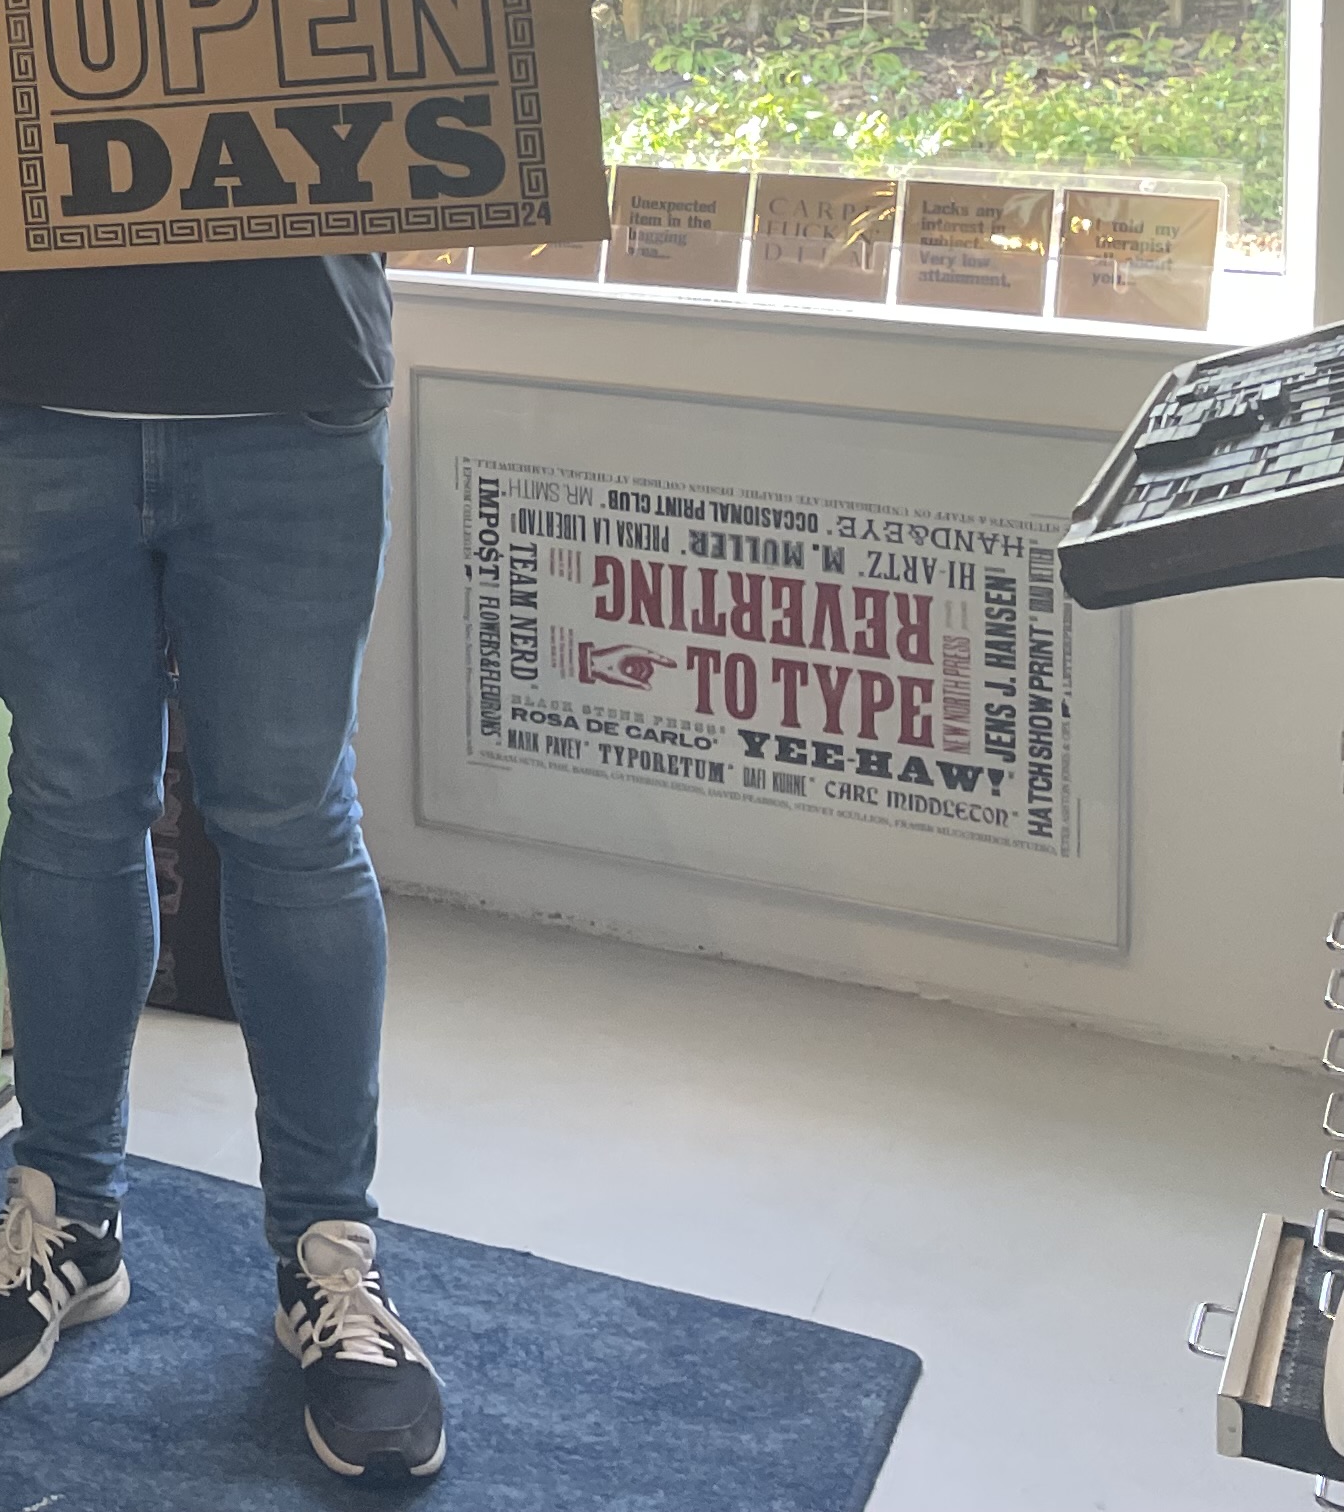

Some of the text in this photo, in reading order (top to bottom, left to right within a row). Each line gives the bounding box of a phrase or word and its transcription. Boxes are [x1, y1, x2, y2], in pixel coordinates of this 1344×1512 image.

[54, 94, 508, 218] DAYS
[521, 200, 551, 227] 24
[629, 212, 712, 229] item in the
[630, 195, 717, 214] Unexpected
[922, 200, 968, 217] Lacks
[1154, 224, 1180, 238] my
[918, 251, 958, 268] Very
[508, 479, 1024, 558] HAND&EYE OCCASIONAL PRINT CLUB MR. SMITH
[518, 507, 586, 541] LIBERTAD
[593, 517, 611, 543] LA
[616, 519, 670, 552] PRENSA
[812, 543, 845, 575] M.
[866, 551, 976, 591] HI-ARTZ
[510, 542, 539, 681] TEAM NERD
[592, 554, 934, 666] REVERTING
[984, 575, 1016, 763] JENS J. HANSEN
[510, 694, 573, 713] BLACK
[685, 646, 937, 749] TO TYPE
[942, 635, 971, 755] NEW NORTH PRESS
[511, 707, 713, 750] ROSA DE CARLO
[507, 729, 539, 753] MARK
[546, 735, 582, 760] PAVEY
[598, 743, 725, 784] TYPORETUM
[824, 780, 879, 805] CARL
[886, 790, 1010, 828] MIDDLETON
[737, 729, 1005, 797] YEE-HAW!
